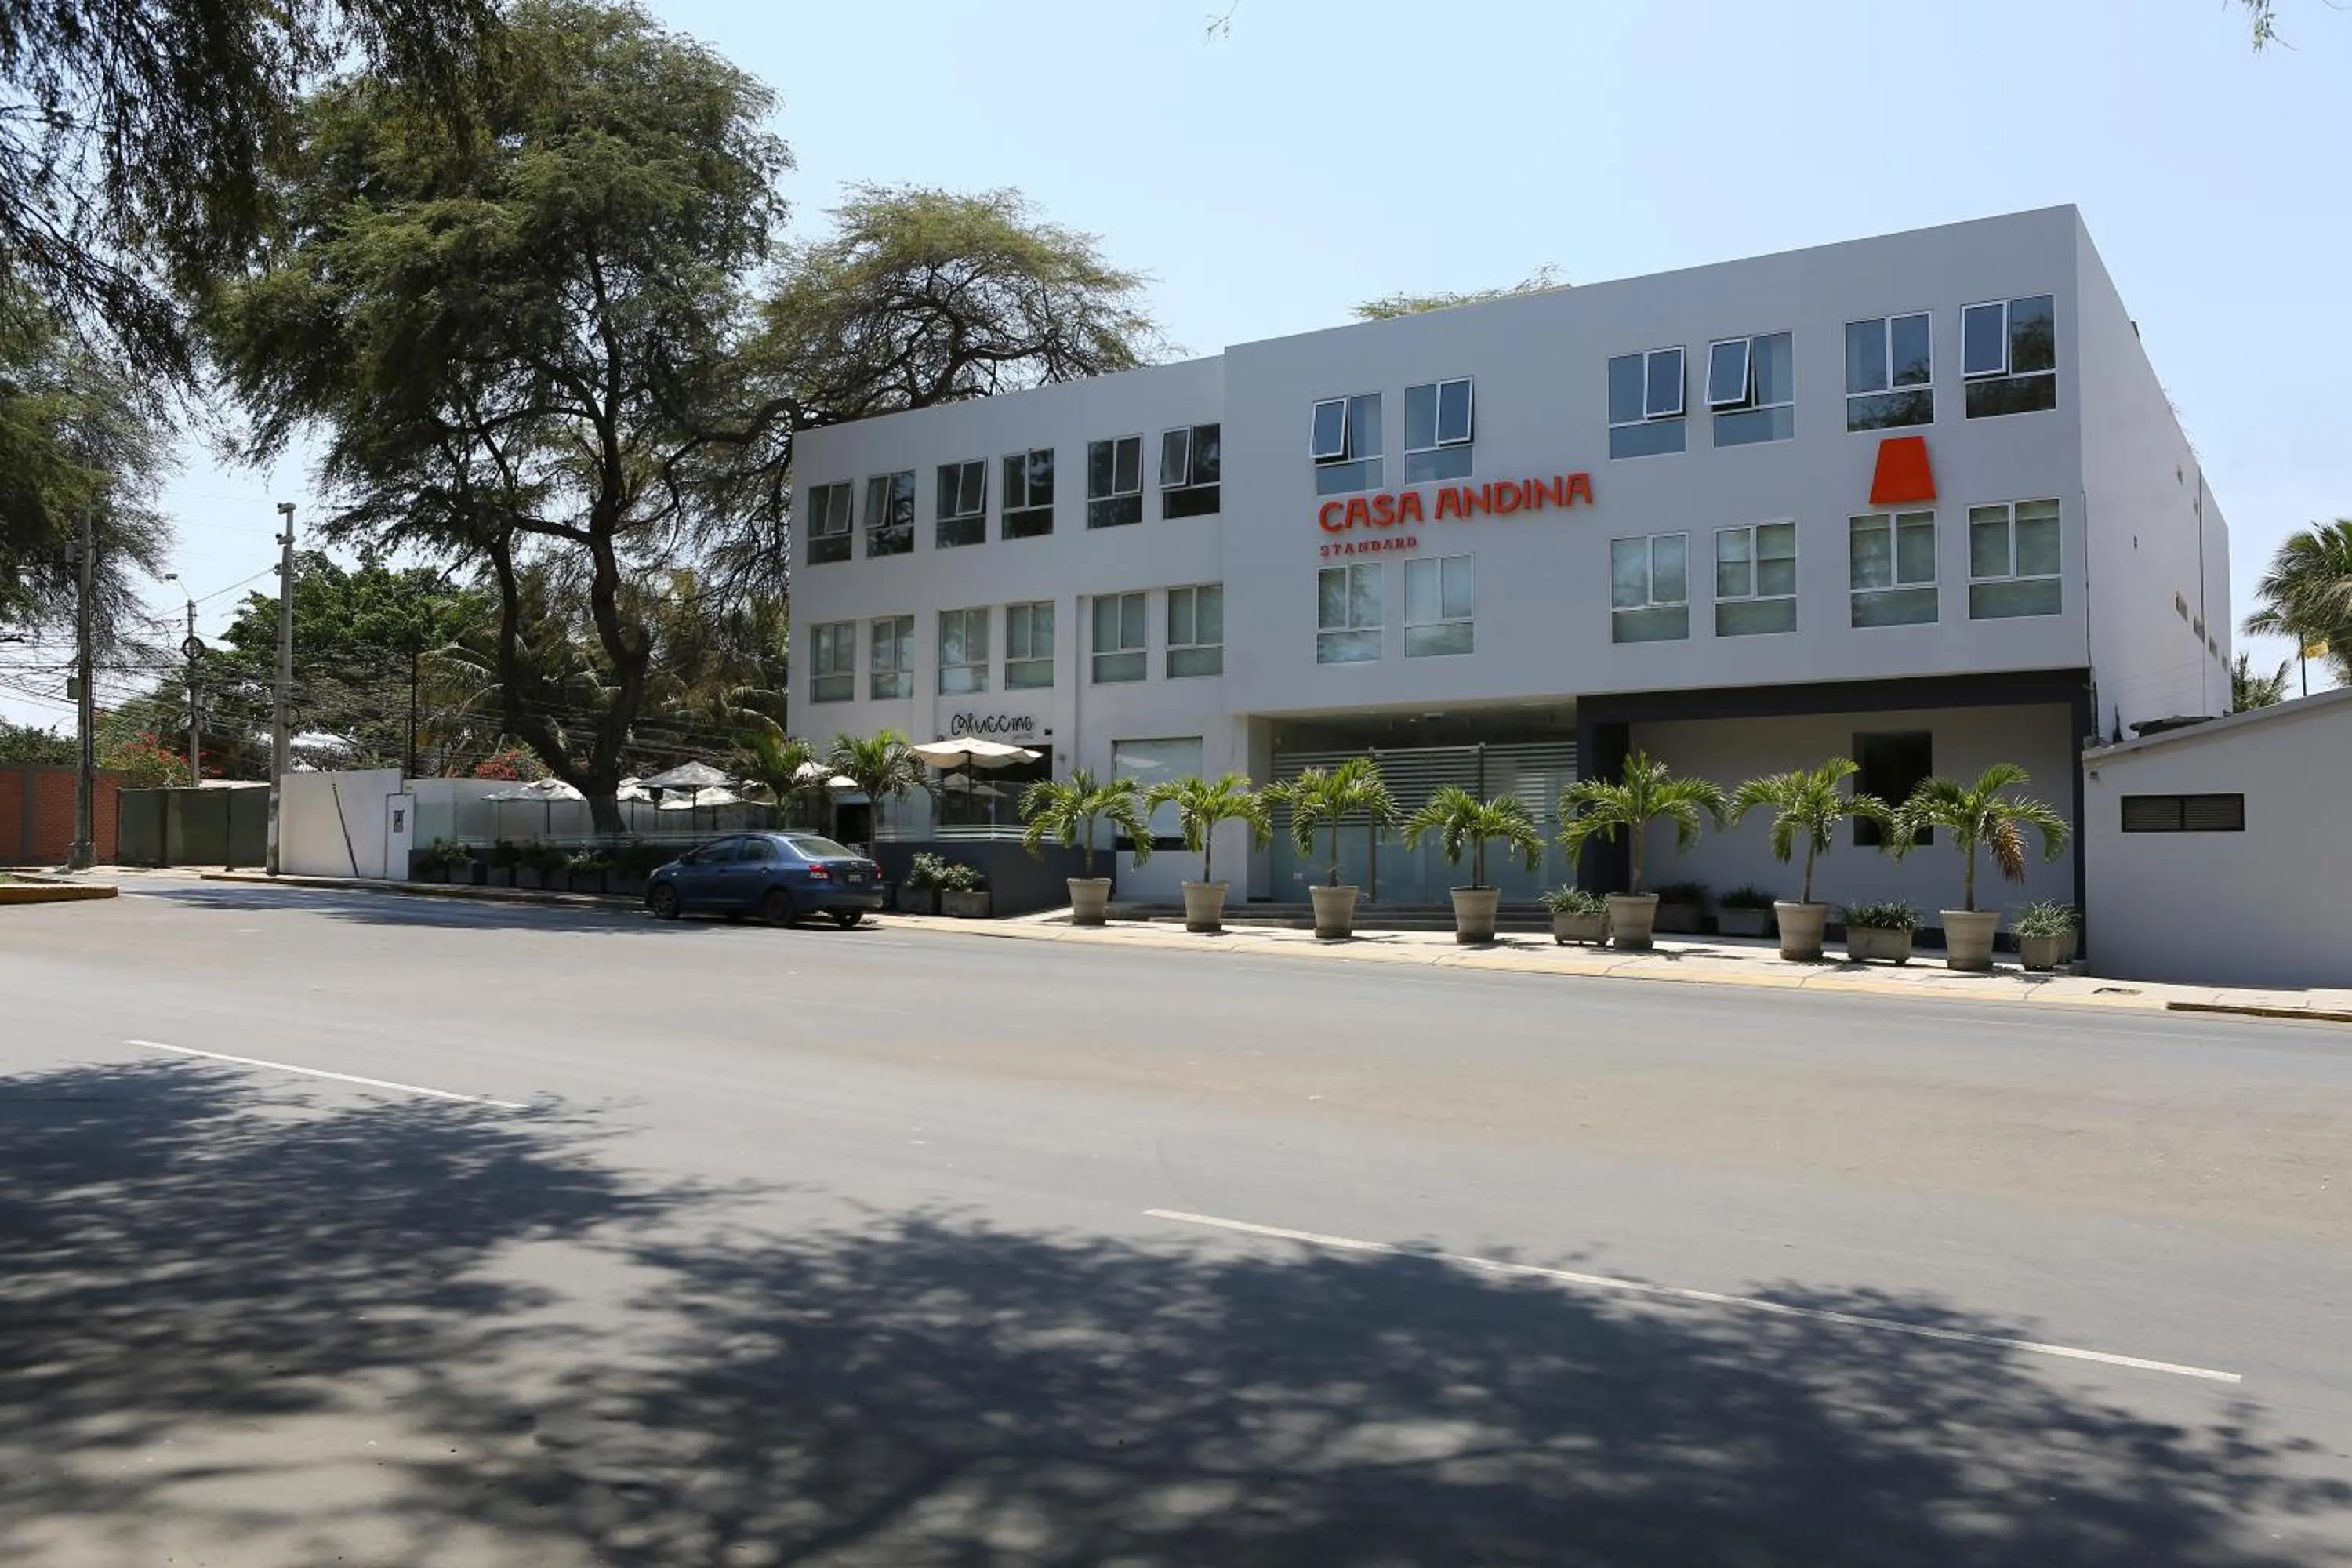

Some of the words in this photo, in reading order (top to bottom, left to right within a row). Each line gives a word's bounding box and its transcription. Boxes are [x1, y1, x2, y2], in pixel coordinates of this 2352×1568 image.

[1319, 491, 1423, 532] CASA
[1435, 473, 1593, 520] ANDINA
[1320, 536, 1417, 557] STANDARD
